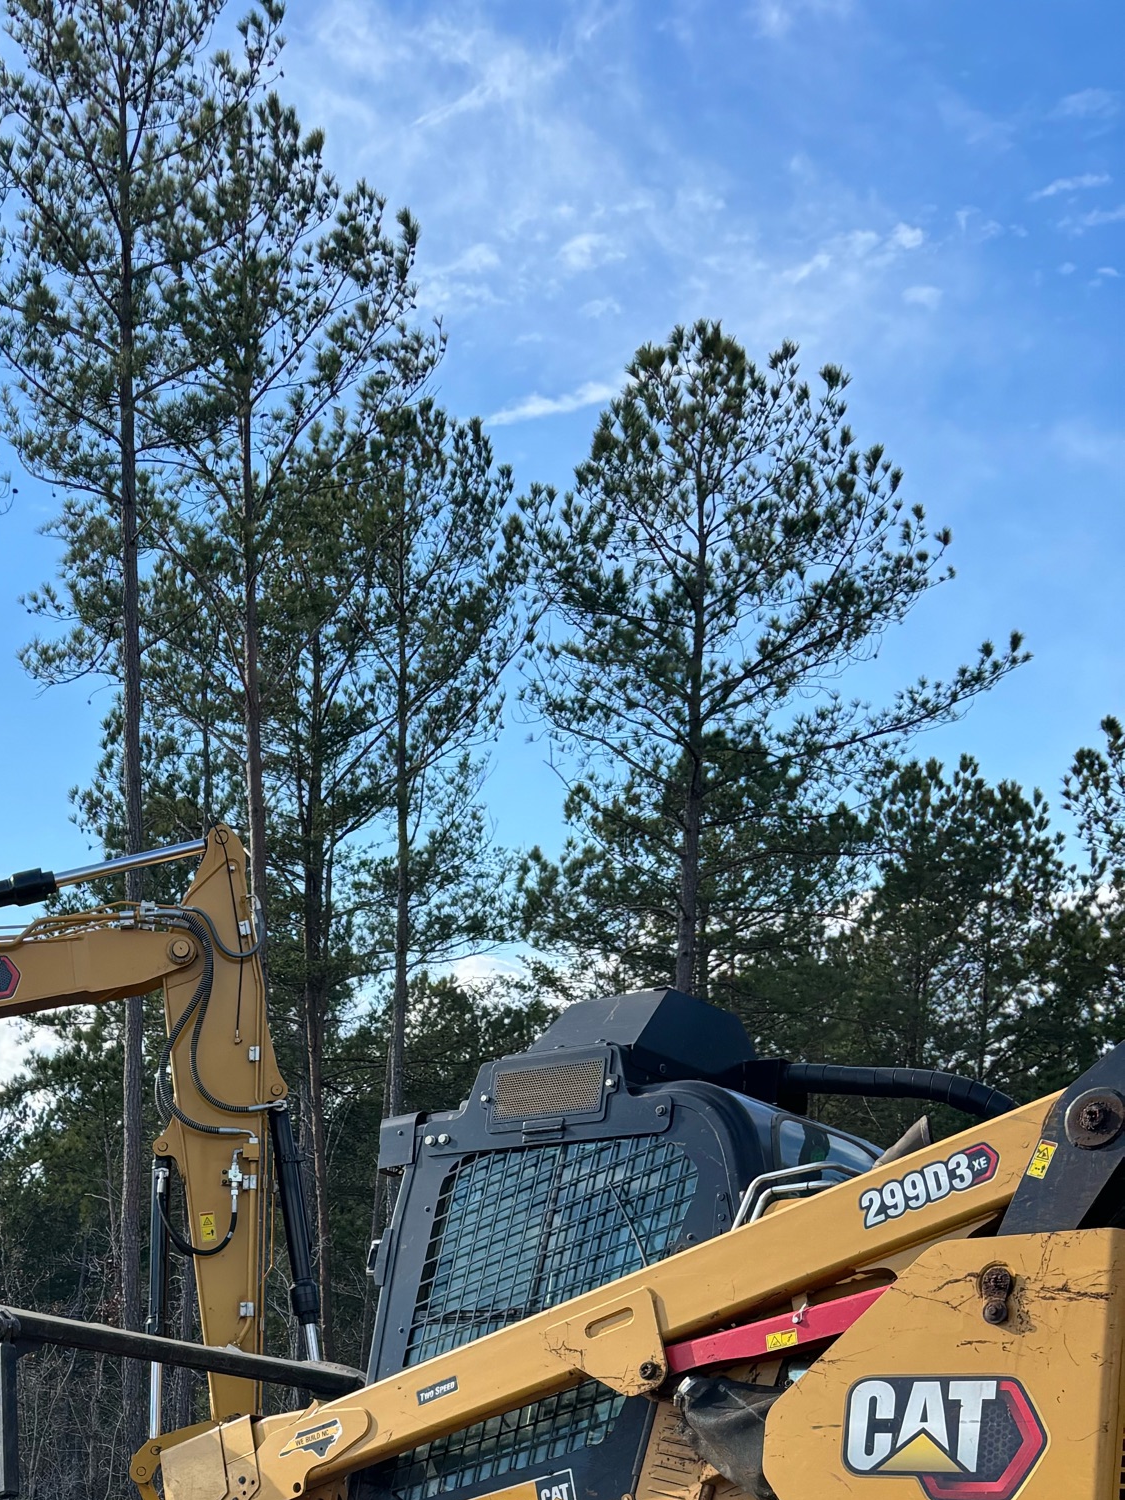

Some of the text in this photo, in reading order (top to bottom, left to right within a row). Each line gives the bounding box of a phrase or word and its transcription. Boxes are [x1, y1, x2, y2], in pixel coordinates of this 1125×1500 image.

[860, 1153, 988, 1227] 299D3 XE
[295, 1429, 330, 1447] WE BUILD NC
[847, 1380, 997, 1473] CAT
